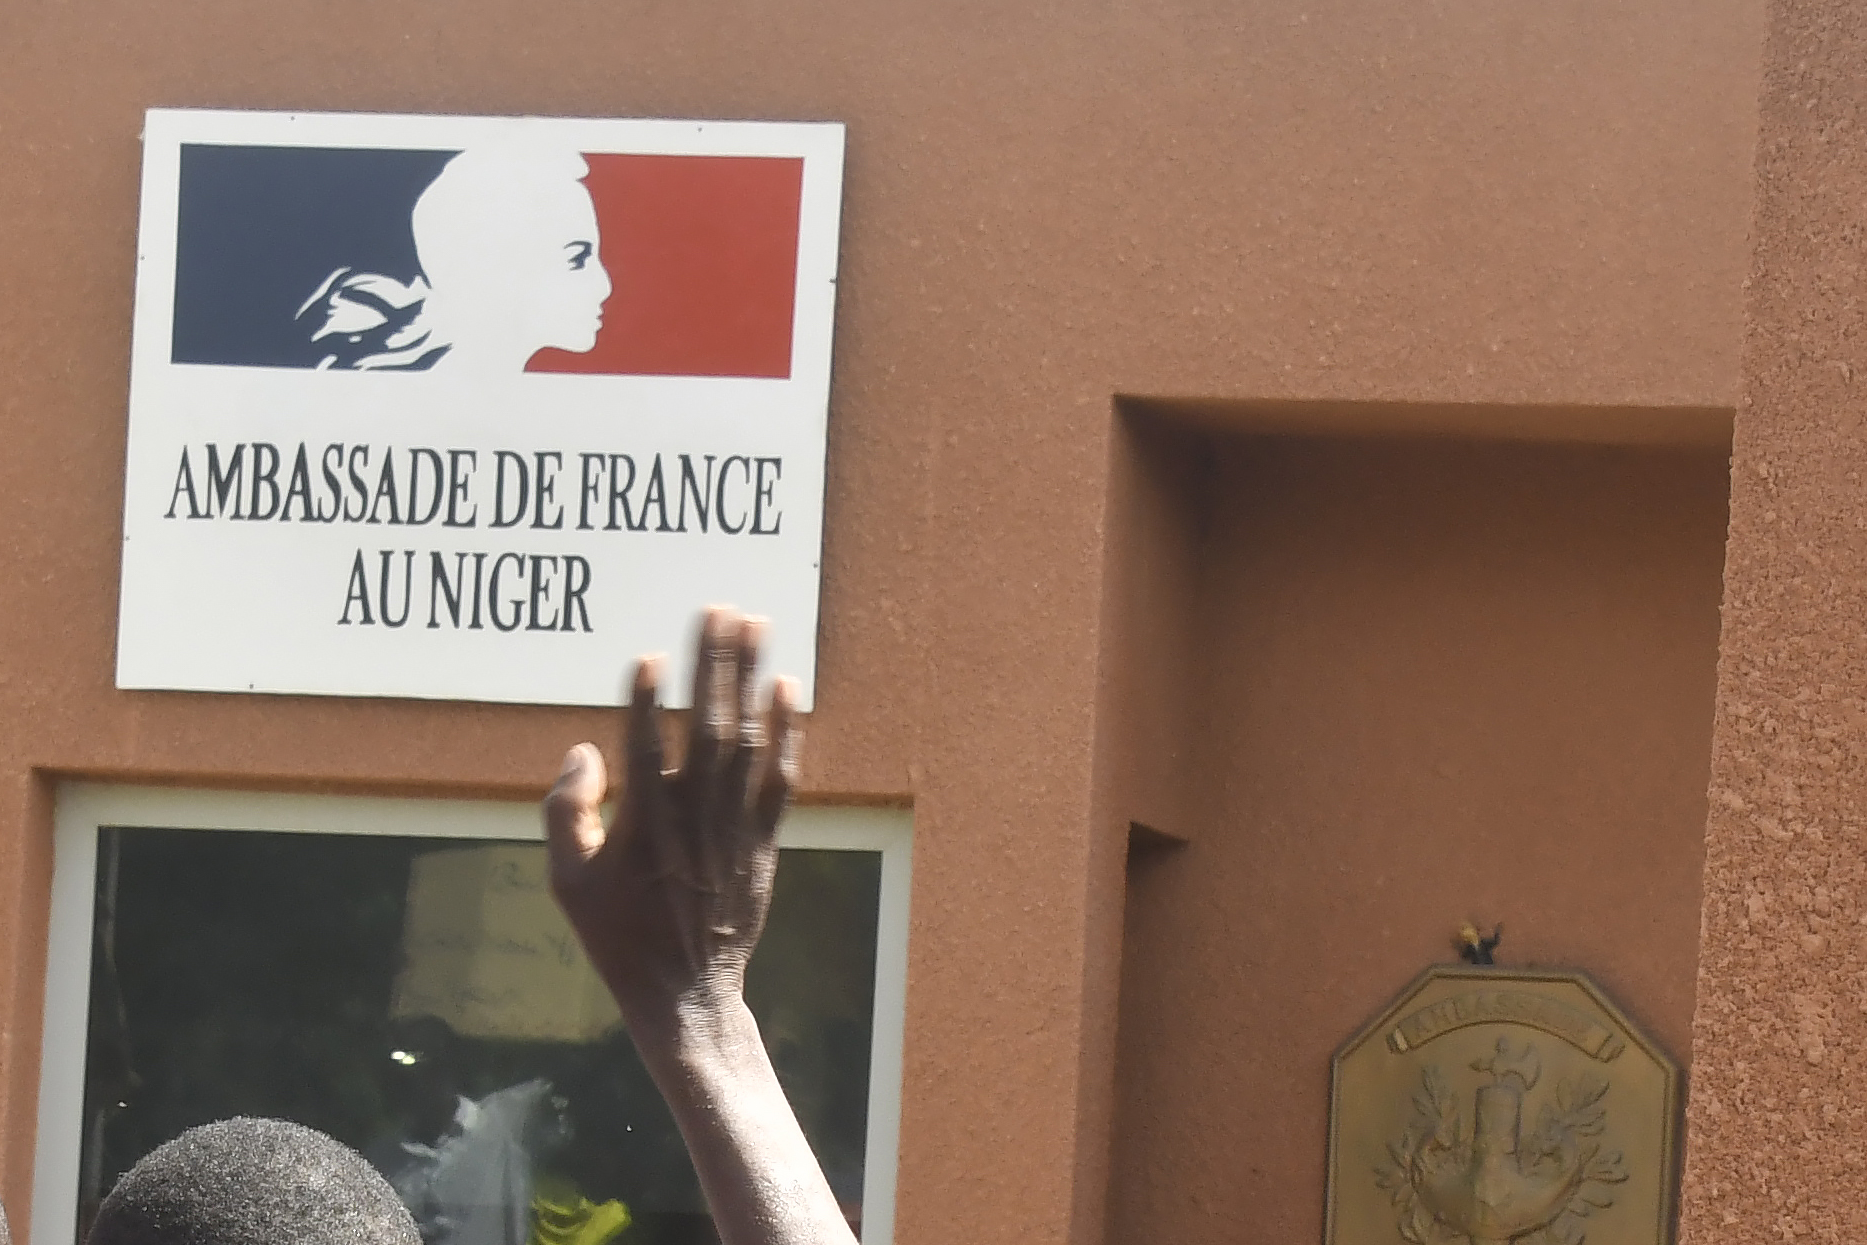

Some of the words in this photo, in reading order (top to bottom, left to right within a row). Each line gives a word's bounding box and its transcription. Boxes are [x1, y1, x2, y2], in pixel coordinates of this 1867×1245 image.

[164, 440, 478, 527] AMBASSADE
[488, 450, 564, 530] DE
[576, 452, 783, 535] FRANCE
[338, 549, 416, 626] AU
[427, 552, 594, 633] NIGER
